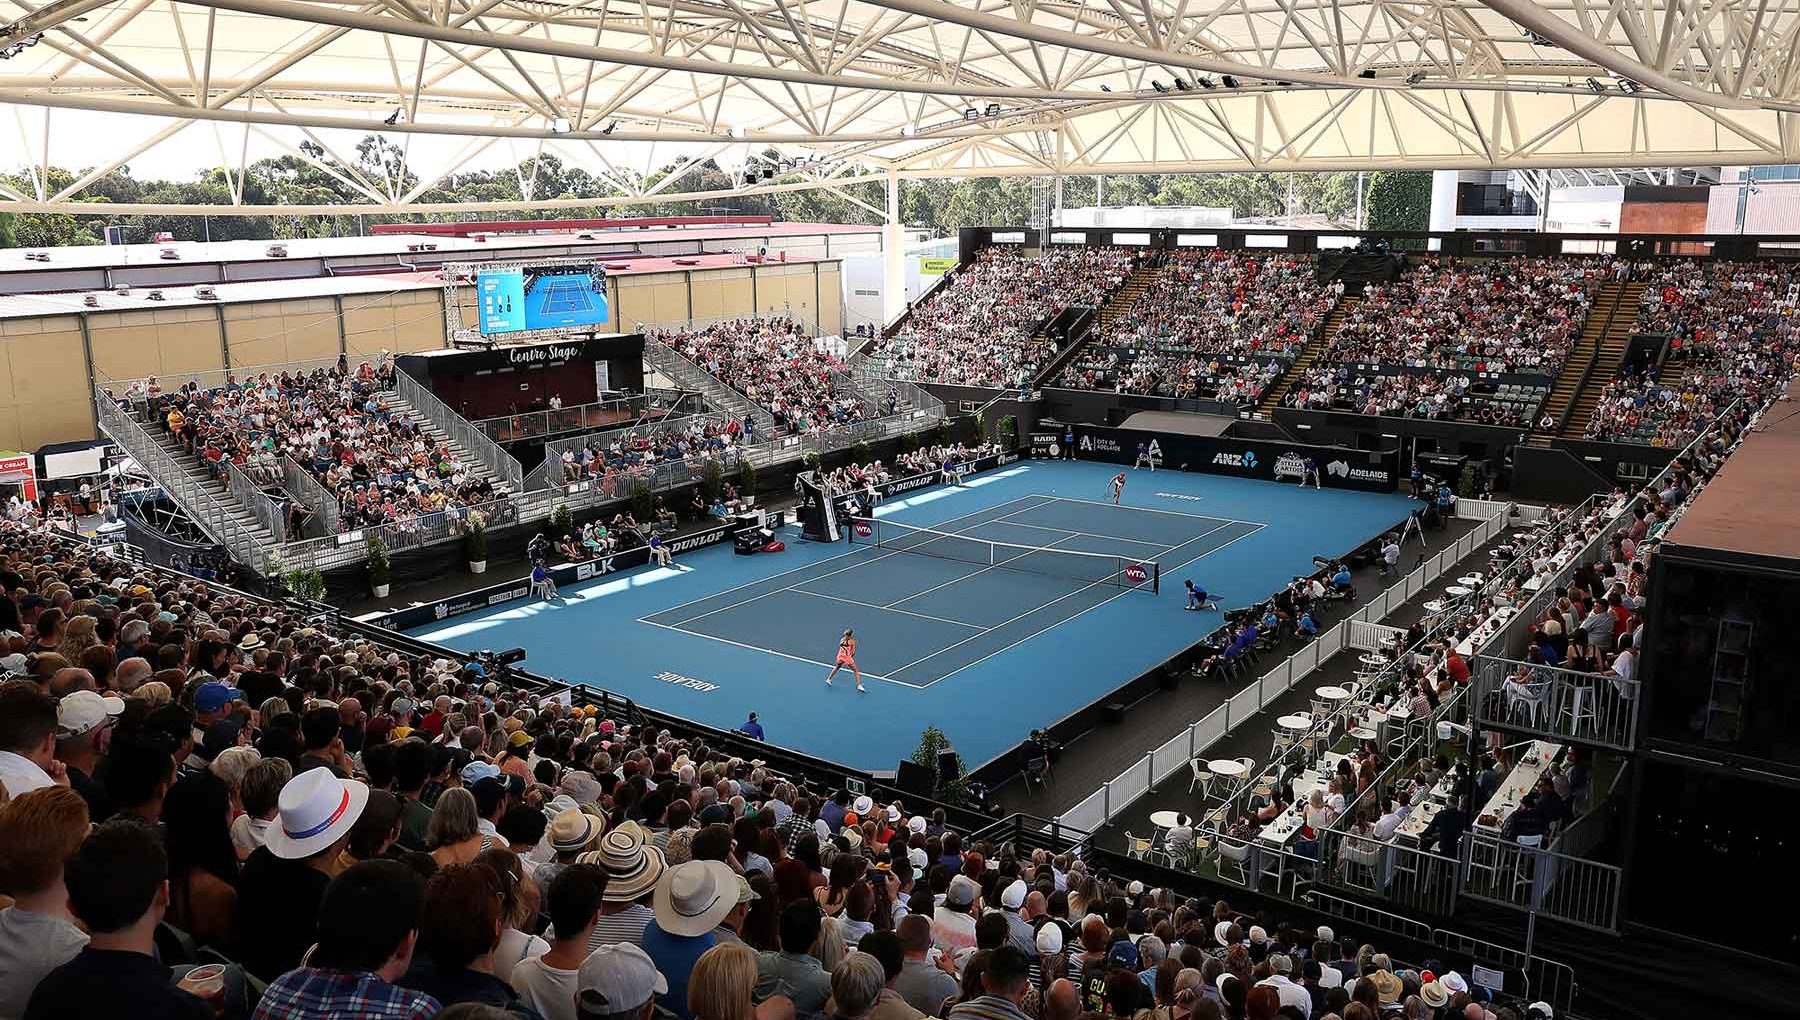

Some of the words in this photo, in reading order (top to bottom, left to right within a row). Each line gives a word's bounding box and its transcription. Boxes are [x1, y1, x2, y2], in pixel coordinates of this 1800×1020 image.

[510, 348, 547, 363] Centre
[549, 344, 578, 361] Stage
[1034, 435, 1057, 443] RADO
[1096, 443, 1121, 452] ADELAIDE
[1212, 452, 1243, 466] ANZ
[955, 462, 978, 477] BLK
[1350, 468, 1389, 479] ADELAIDE
[895, 475, 934, 493] DUNLOP
[855, 525, 872, 534] WTA
[671, 530, 726, 553] DUNLOP
[577, 557, 617, 581] BLK
[1126, 569, 1146, 579] WTA
[652, 671, 721, 692] ADELAIDE
